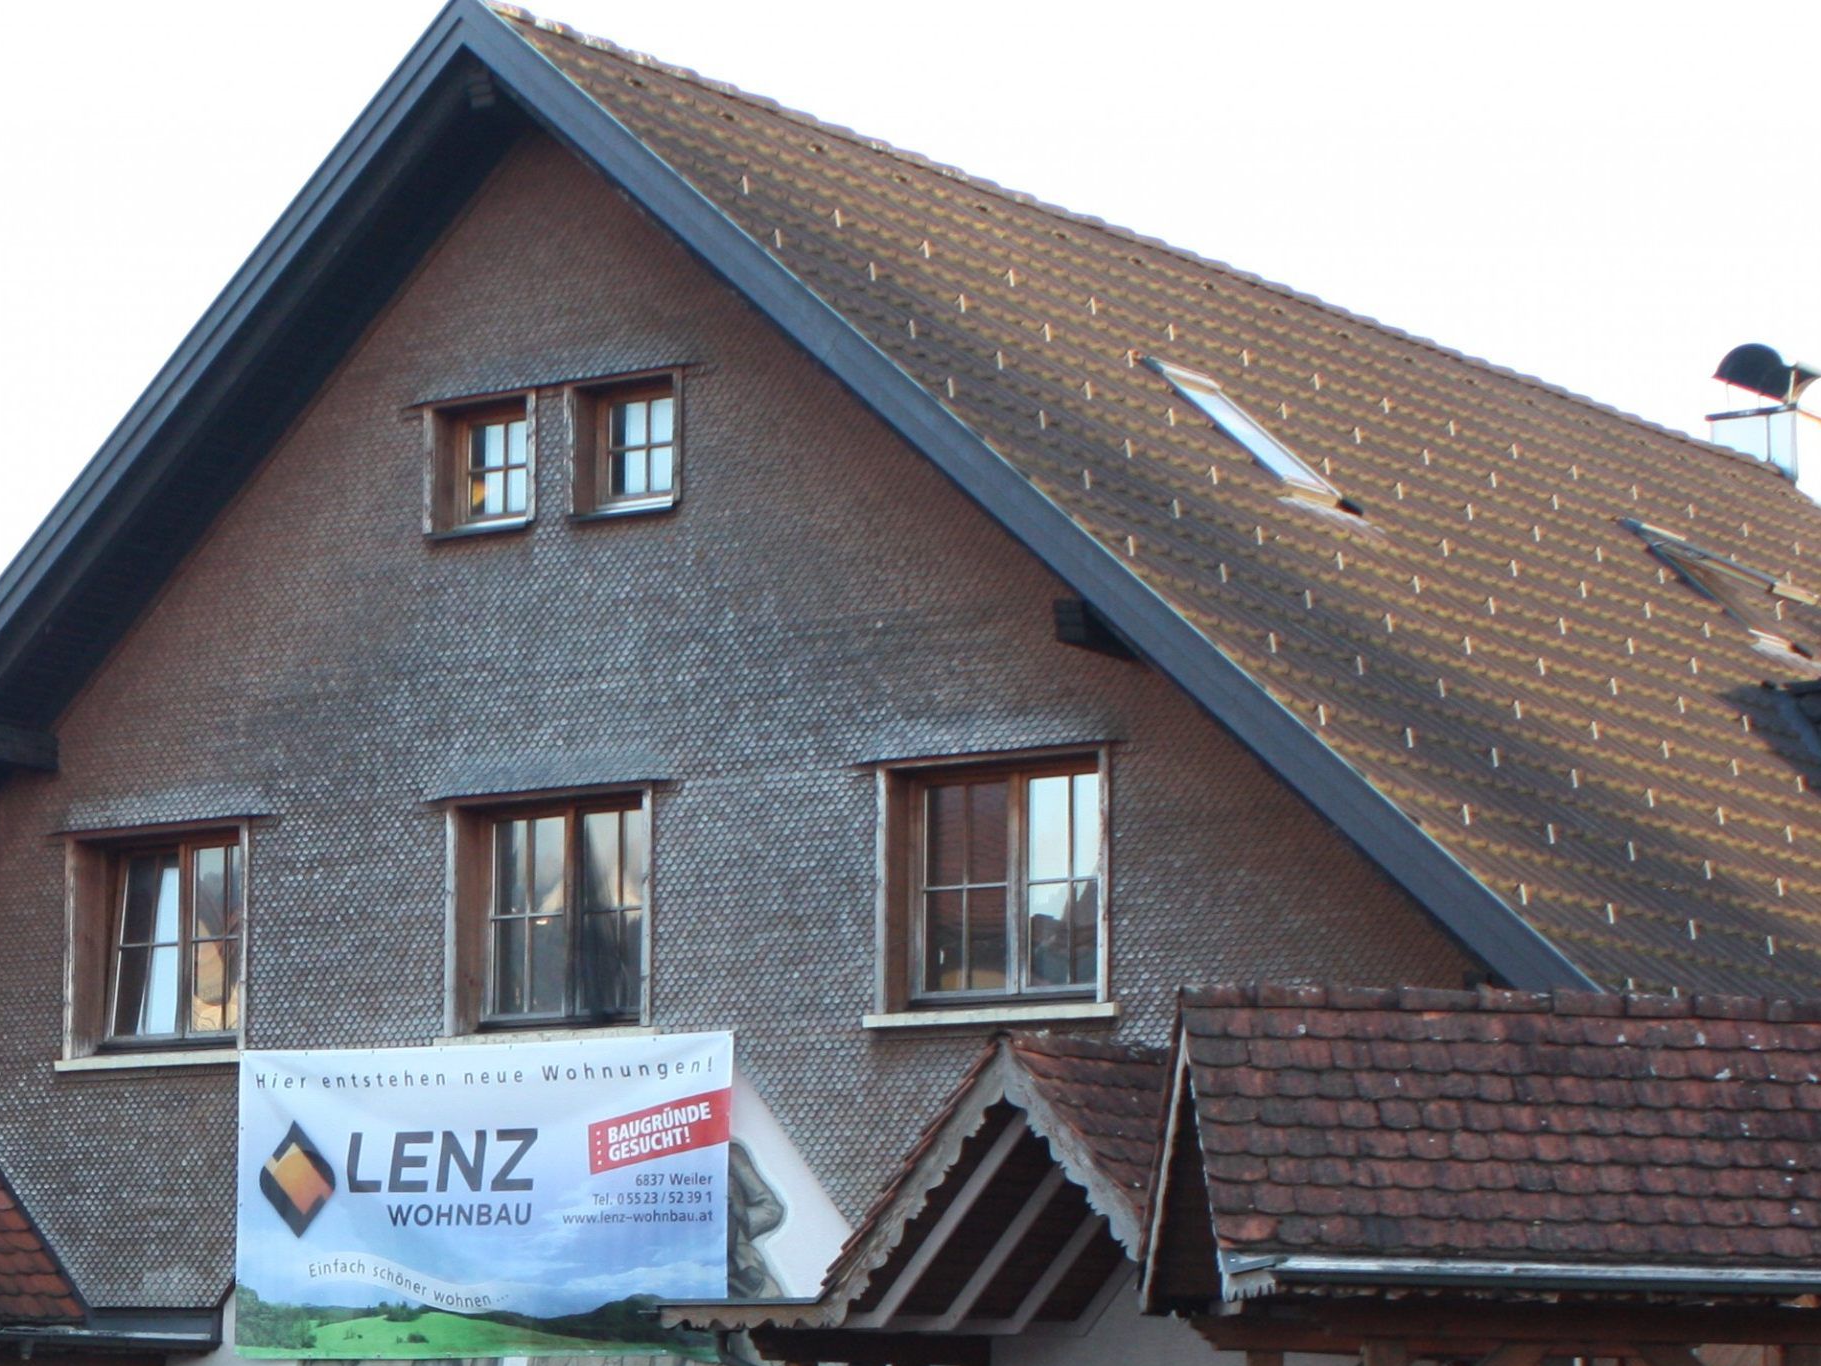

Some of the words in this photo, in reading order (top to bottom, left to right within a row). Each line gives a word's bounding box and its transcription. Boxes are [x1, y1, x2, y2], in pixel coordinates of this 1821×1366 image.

[256, 1073, 307, 1089] Hier
[322, 1070, 446, 1089] entstehen
[464, 1070, 524, 1085] neue
[542, 1057, 713, 1082] Wohnungen!
[607, 1102, 712, 1144] BAUGRÜNDE
[608, 1126, 691, 1162] GESUCHT!
[347, 1128, 538, 1193] LENZ
[635, 1174, 665, 1187] 6837
[669, 1173, 713, 1186] Weiler
[386, 1203, 532, 1227] WOHNBAU
[593, 1193, 613, 1206] Tel.
[562, 1210, 714, 1225] www.lenz-wohnbau.at
[309, 1258, 366, 1278] Einfach
[373, 1266, 427, 1297] schöner
[433, 1290, 492, 1308] wohnen
